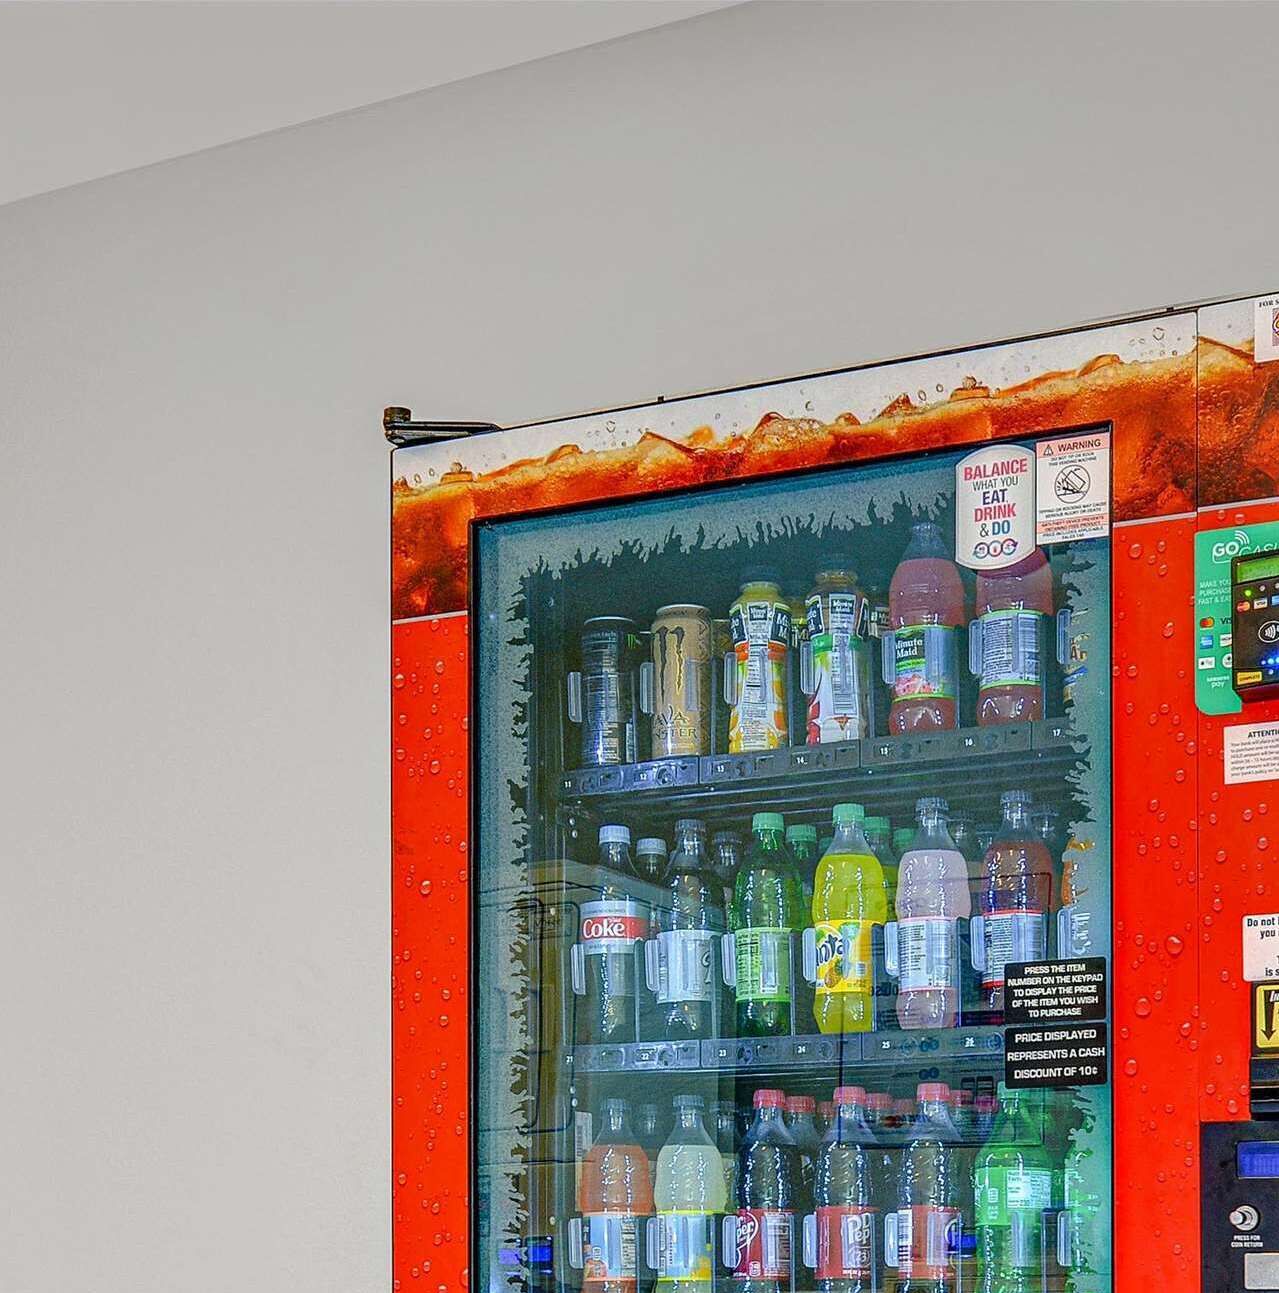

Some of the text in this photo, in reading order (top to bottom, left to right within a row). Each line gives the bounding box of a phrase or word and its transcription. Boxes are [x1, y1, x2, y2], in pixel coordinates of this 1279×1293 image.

[1259, 300, 1274, 308] FOR
[1057, 439, 1101, 452] WARNING
[963, 457, 1028, 481] BALANCE
[973, 476, 1019, 491] WHAT YOU
[974, 503, 1016, 522] DRINK
[979, 520, 1011, 538] & DO
[1213, 541, 1239, 557] GO
[896, 647, 918, 659] Maid
[583, 919, 625, 938] Coke
[1015, 1029, 1097, 1043] PRICE DISPLAYED
[1007, 1047, 1106, 1061] REPRESENTS A CASH
[1014, 1066, 1098, 1079] DISCOUNT OF 10¢
